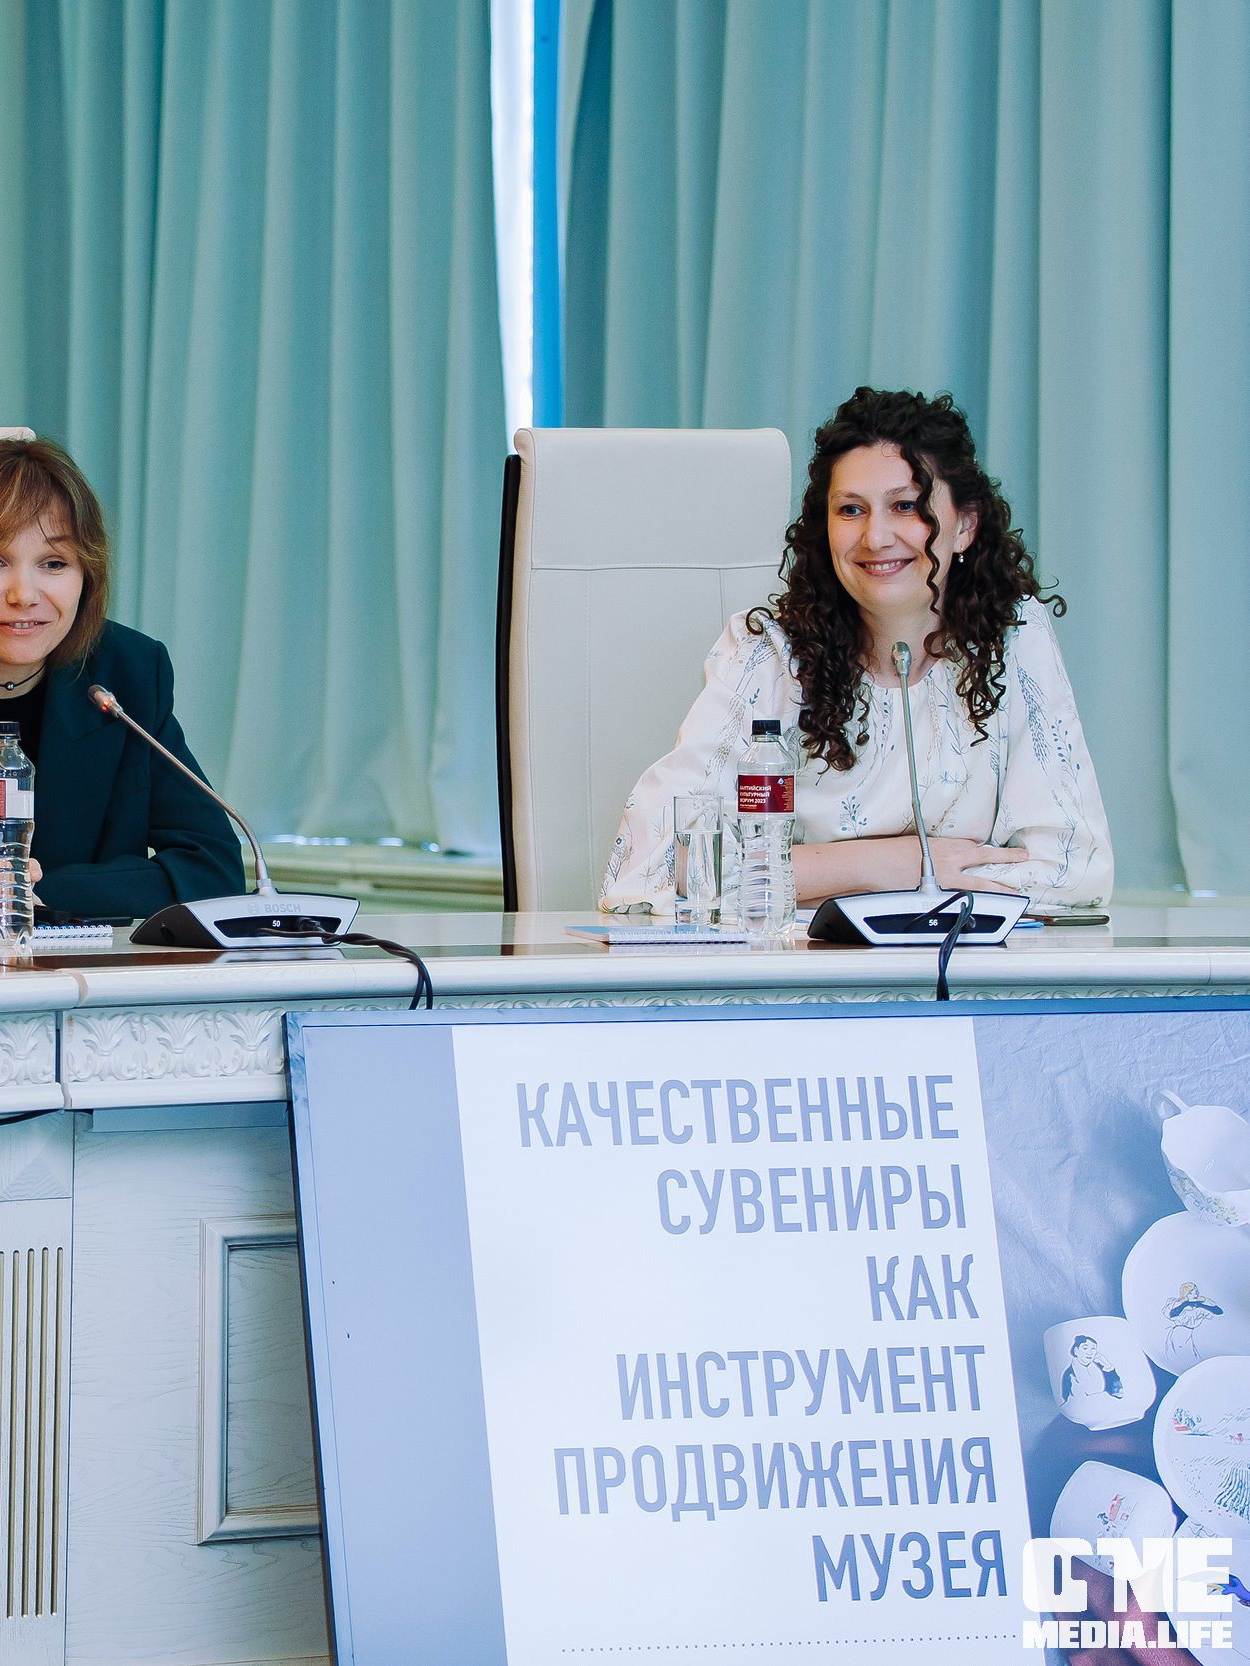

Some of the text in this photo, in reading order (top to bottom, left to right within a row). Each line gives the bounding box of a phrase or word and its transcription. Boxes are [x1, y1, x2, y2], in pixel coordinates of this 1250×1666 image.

[264, 903, 301, 913] BOSCH
[272, 920, 281, 928] 50
[515, 1075, 959, 1147] КАЧЕСТВЕННЫЕ
[657, 1164, 967, 1234] СУВЕНИРЫ
[866, 1254, 980, 1321] КАК
[616, 1345, 985, 1420] ИНСТРУМЕНТ
[553, 1437, 998, 1522] ПРОДВИЖЕНИЯ
[812, 1530, 1008, 1602] МУЗЕЯ
